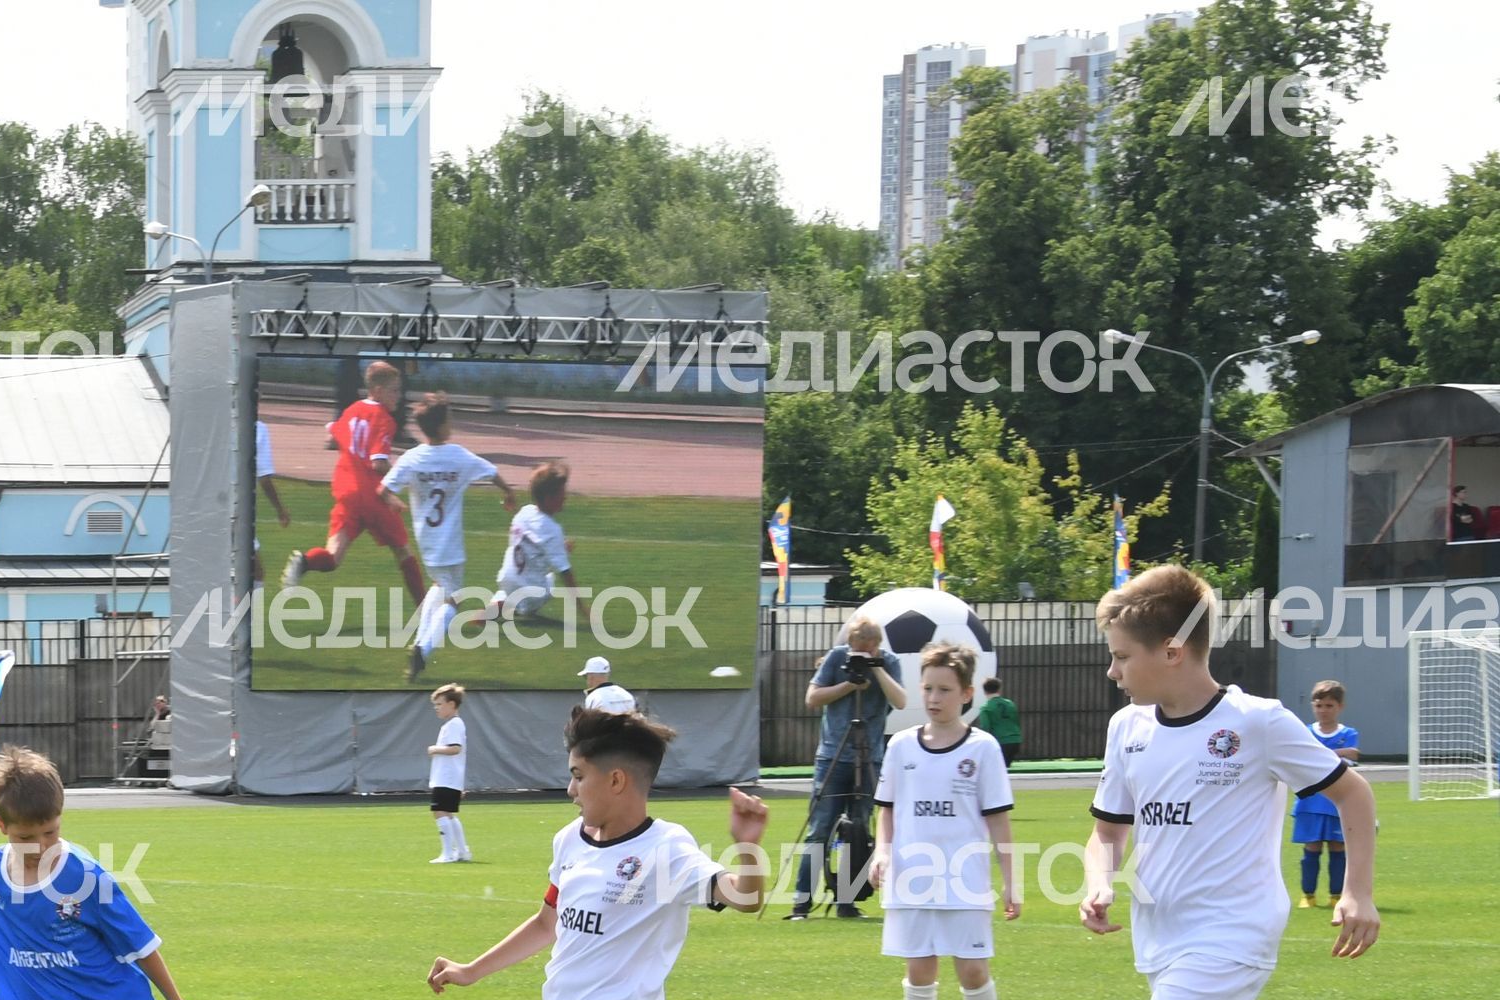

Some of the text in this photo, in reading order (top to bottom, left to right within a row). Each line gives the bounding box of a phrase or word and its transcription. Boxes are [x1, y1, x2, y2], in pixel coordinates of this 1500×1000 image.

[348, 416, 370, 459] 10
[426, 488, 446, 528] 3
[914, 800, 956, 816] ISRAEL
[1141, 801, 1193, 826] ISRAEL
[560, 907, 605, 936] ISRAEL
[9, 947, 80, 969] ARGENTINA
